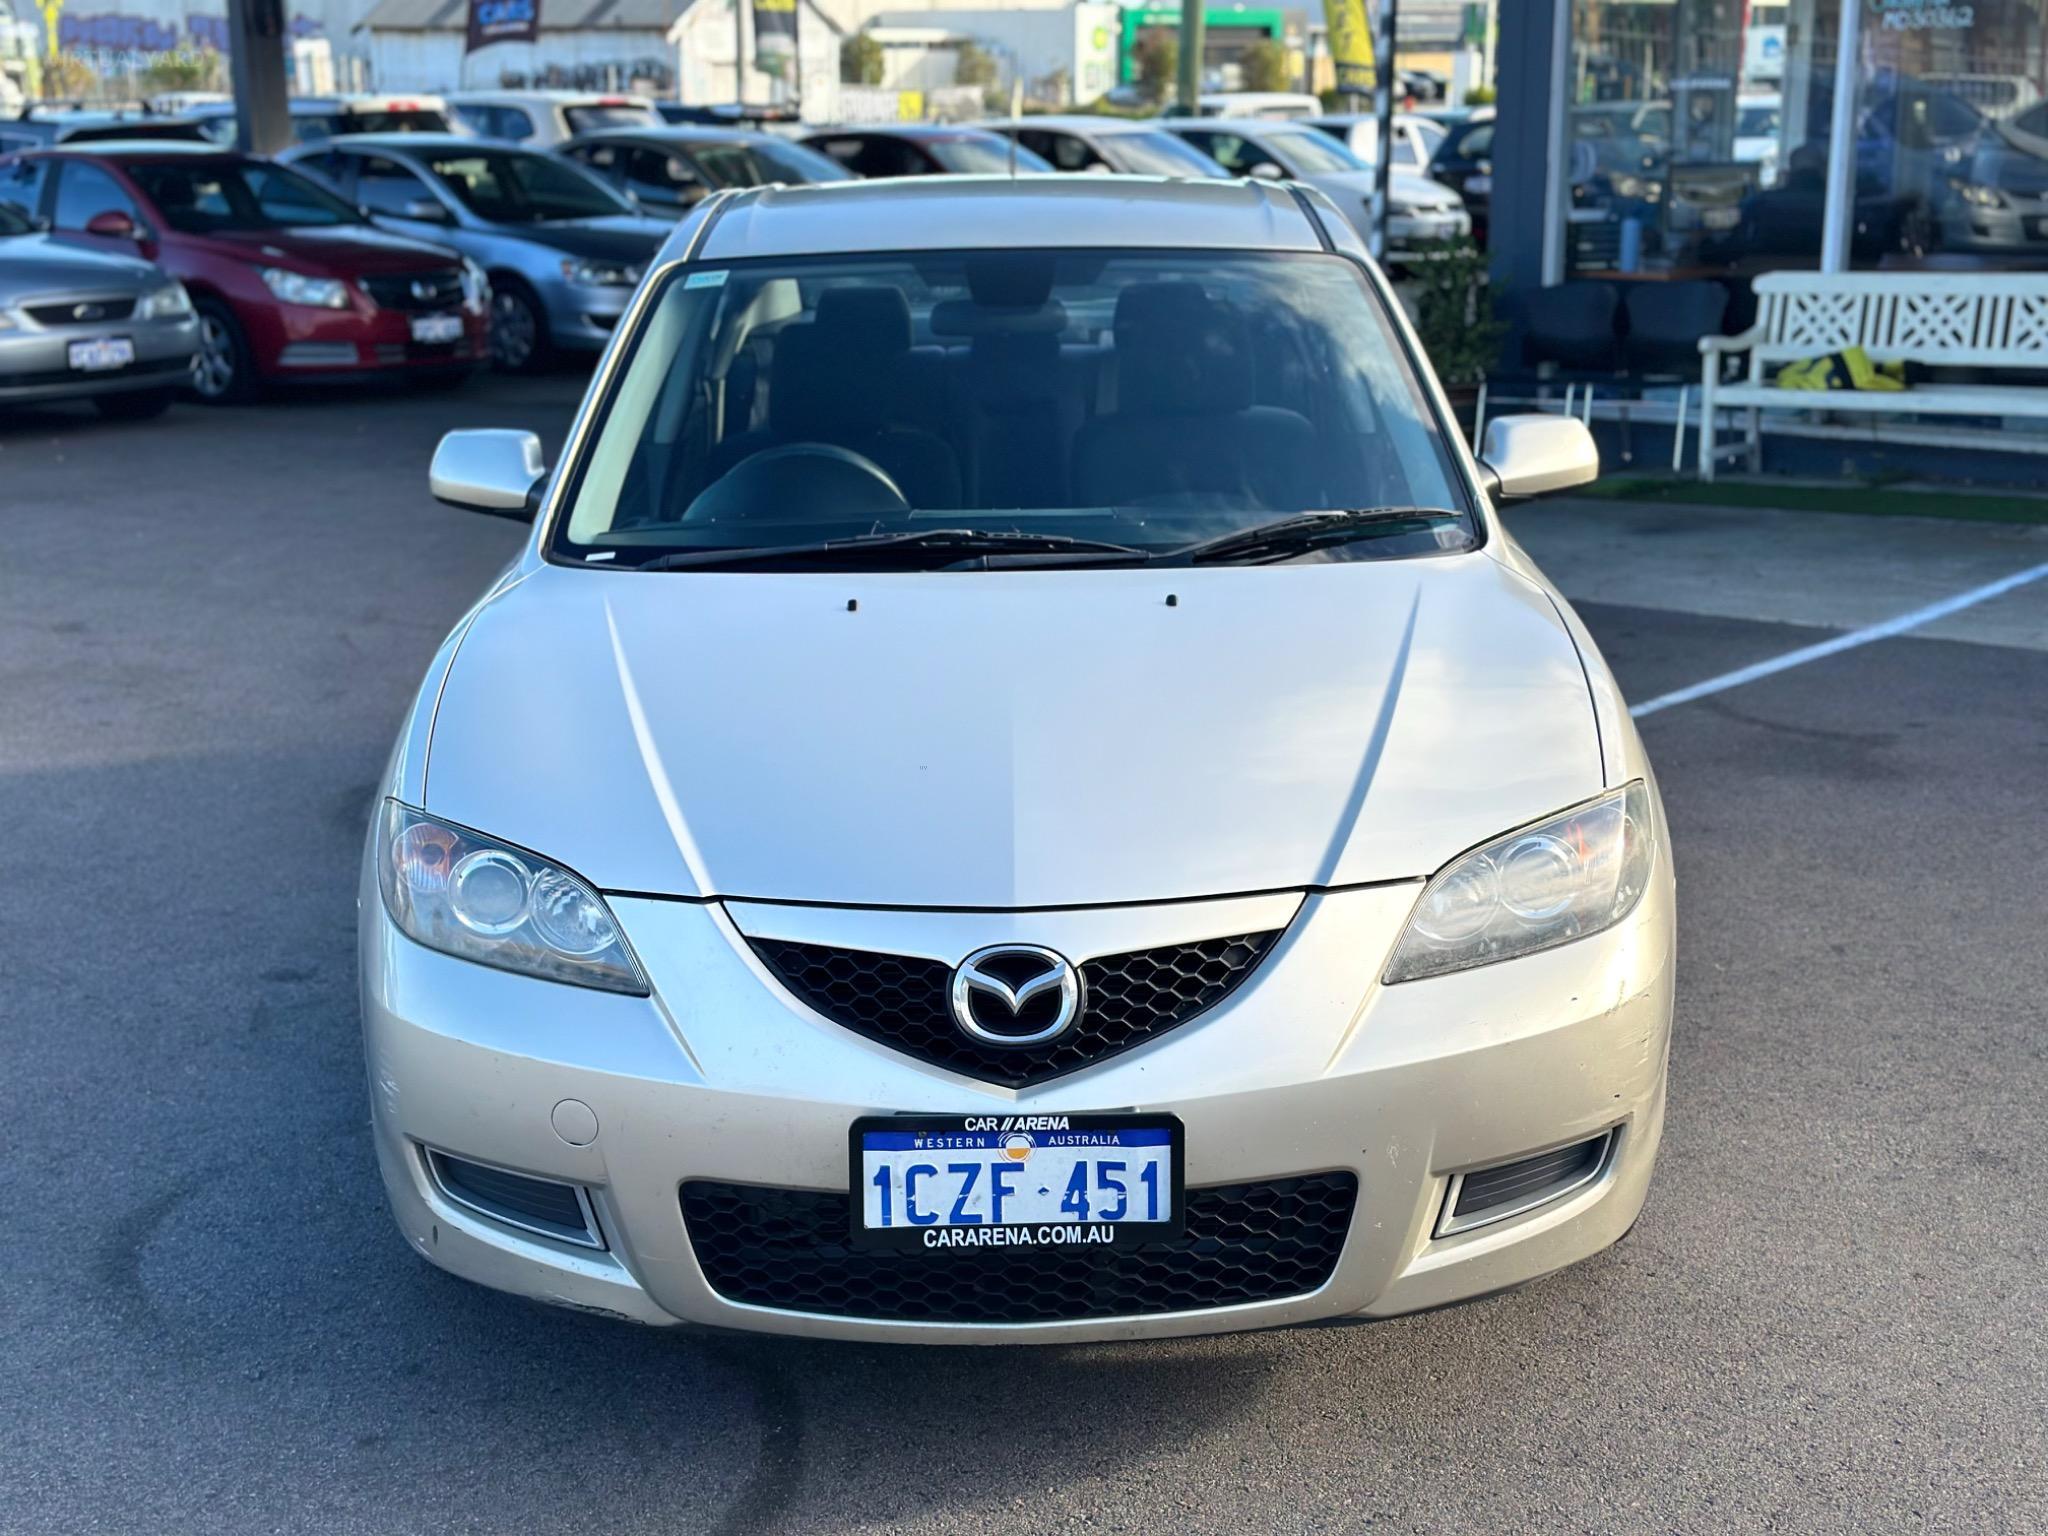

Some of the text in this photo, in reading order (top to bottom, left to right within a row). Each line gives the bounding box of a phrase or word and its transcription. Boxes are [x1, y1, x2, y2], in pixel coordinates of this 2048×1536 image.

[964, 1117, 998, 1131] CAR
[914, 1135, 1120, 1149] WESTERN AUSTRALIA
[923, 1225, 1114, 1248] CARARENA.COM.AU
